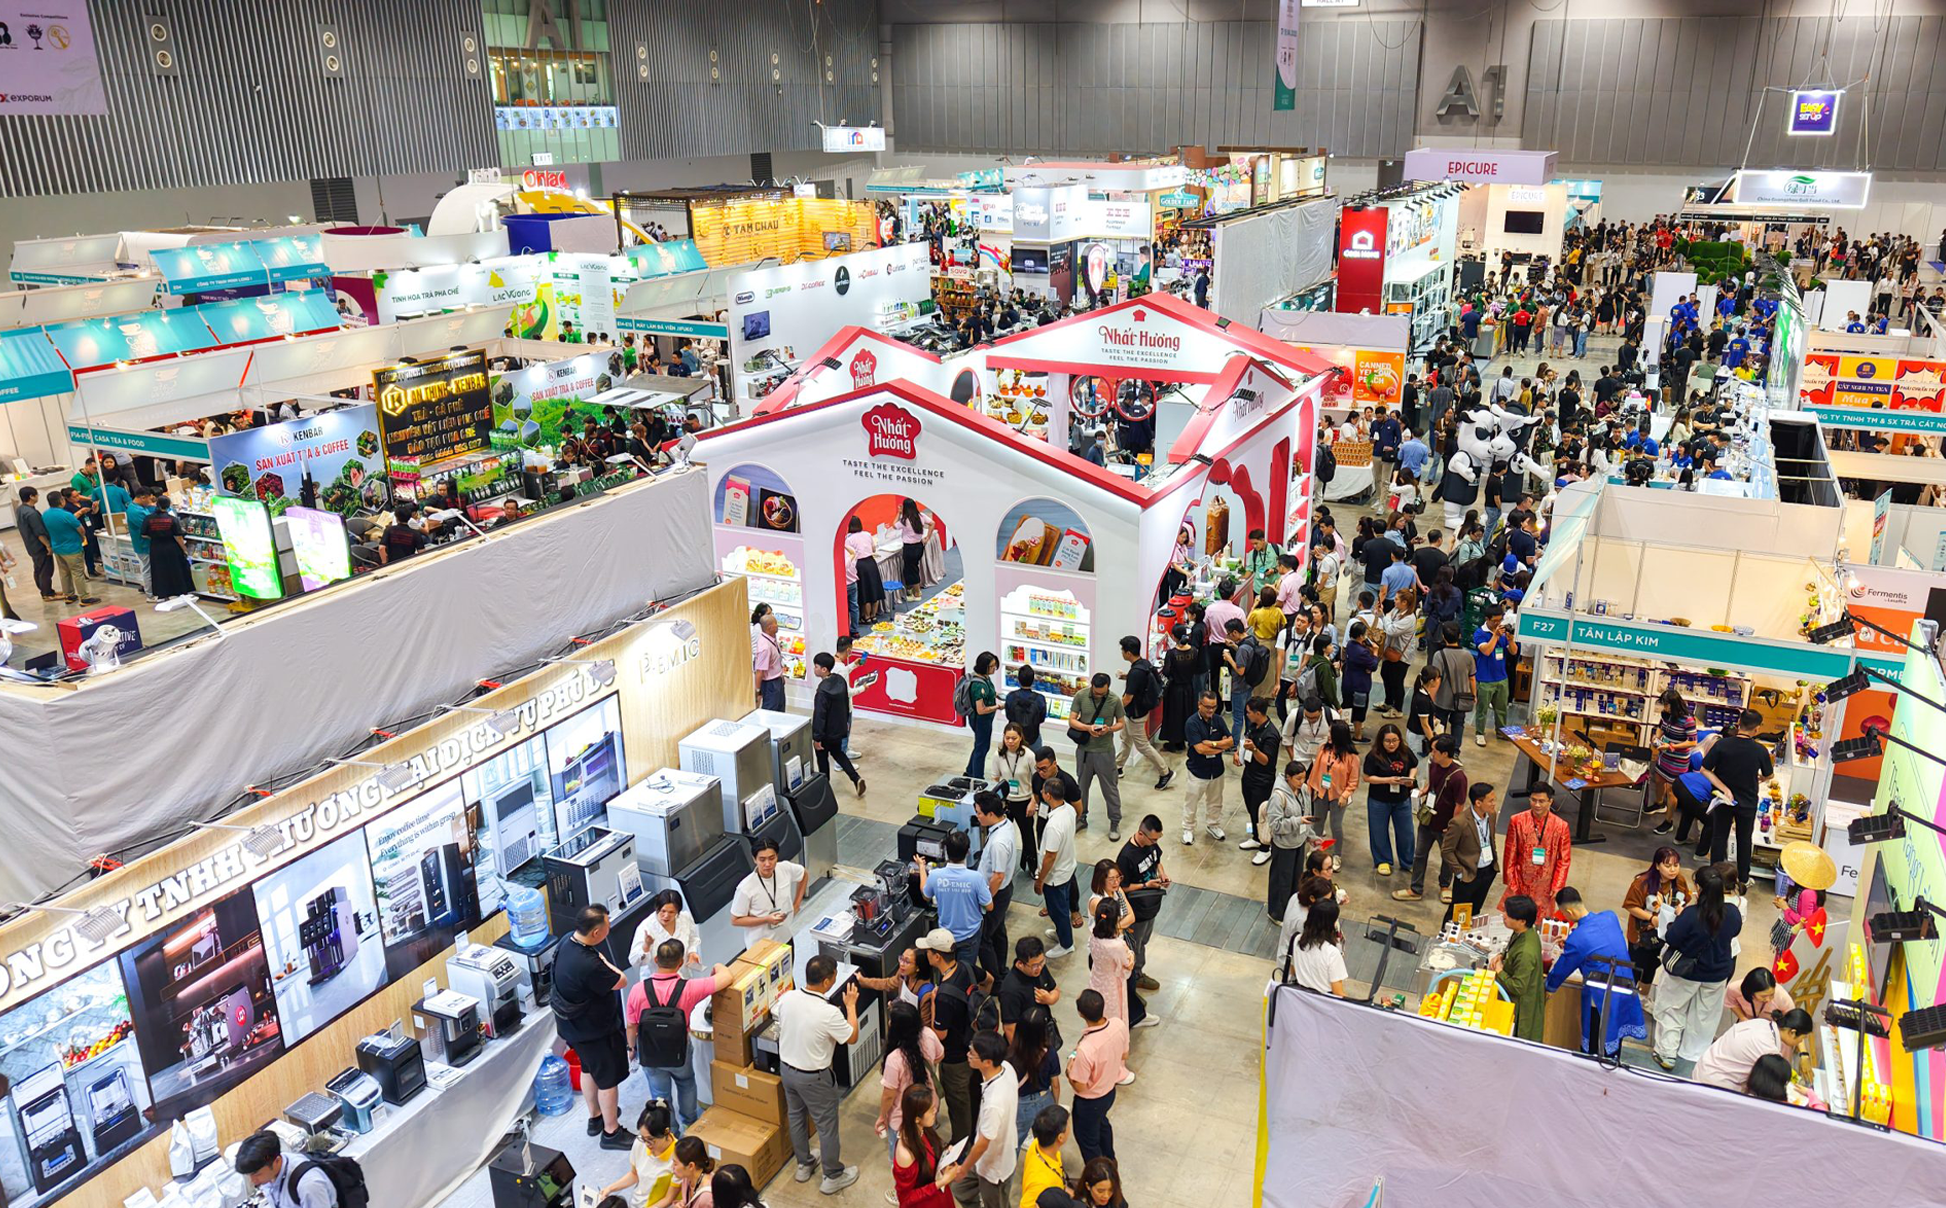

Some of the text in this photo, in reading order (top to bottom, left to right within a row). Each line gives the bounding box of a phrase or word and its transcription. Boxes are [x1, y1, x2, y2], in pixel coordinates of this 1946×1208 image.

[1436, 64, 1507, 120] A1
[1448, 161, 1498, 175] EPICURE
[392, 294, 406, 303] TINH
[407, 292, 421, 301] HOA
[422, 289, 434, 299] TRÀ
[434, 289, 447, 298] PHA
[1099, 325, 1180, 351] Nhất Hương
[1101, 347, 1121, 355] TASTE
[1137, 350, 1177, 358] EXCELLENCE
[871, 415, 912, 438] Nhất
[1843, 415, 1864, 423] TNHH
[1867, 415, 1878, 424] TM
[1887, 418, 1898, 426] SX
[1900, 416, 1916, 427] TRÀ
[1918, 418, 1934, 428] CÁT
[94, 434, 110, 444] CASA
[110, 436, 123, 446] TEA
[128, 438, 145, 448] FOOD
[293, 426, 323, 441] KENBAR
[314, 446, 321, 457] &
[321, 439, 349, 455] COFFEE
[873, 433, 911, 454] Hương
[843, 459, 944, 478] TASTE THE EXCELLENCE
[854, 470, 933, 485] FEEL THE PASSION
[1867, 588, 1908, 600] Fermentis
[1533, 621, 1659, 647] F27 TÂN LẬP KIM
[135, 843, 247, 922] TNHH
[254, 776, 382, 867] HƯƠNG
[539, 667, 585, 720] PHÚ
[378, 812, 430, 846] Enjoy coffee time
[380, 835, 415, 858] Everything
[420, 821, 440, 835] within
[439, 811, 456, 828] grasp
